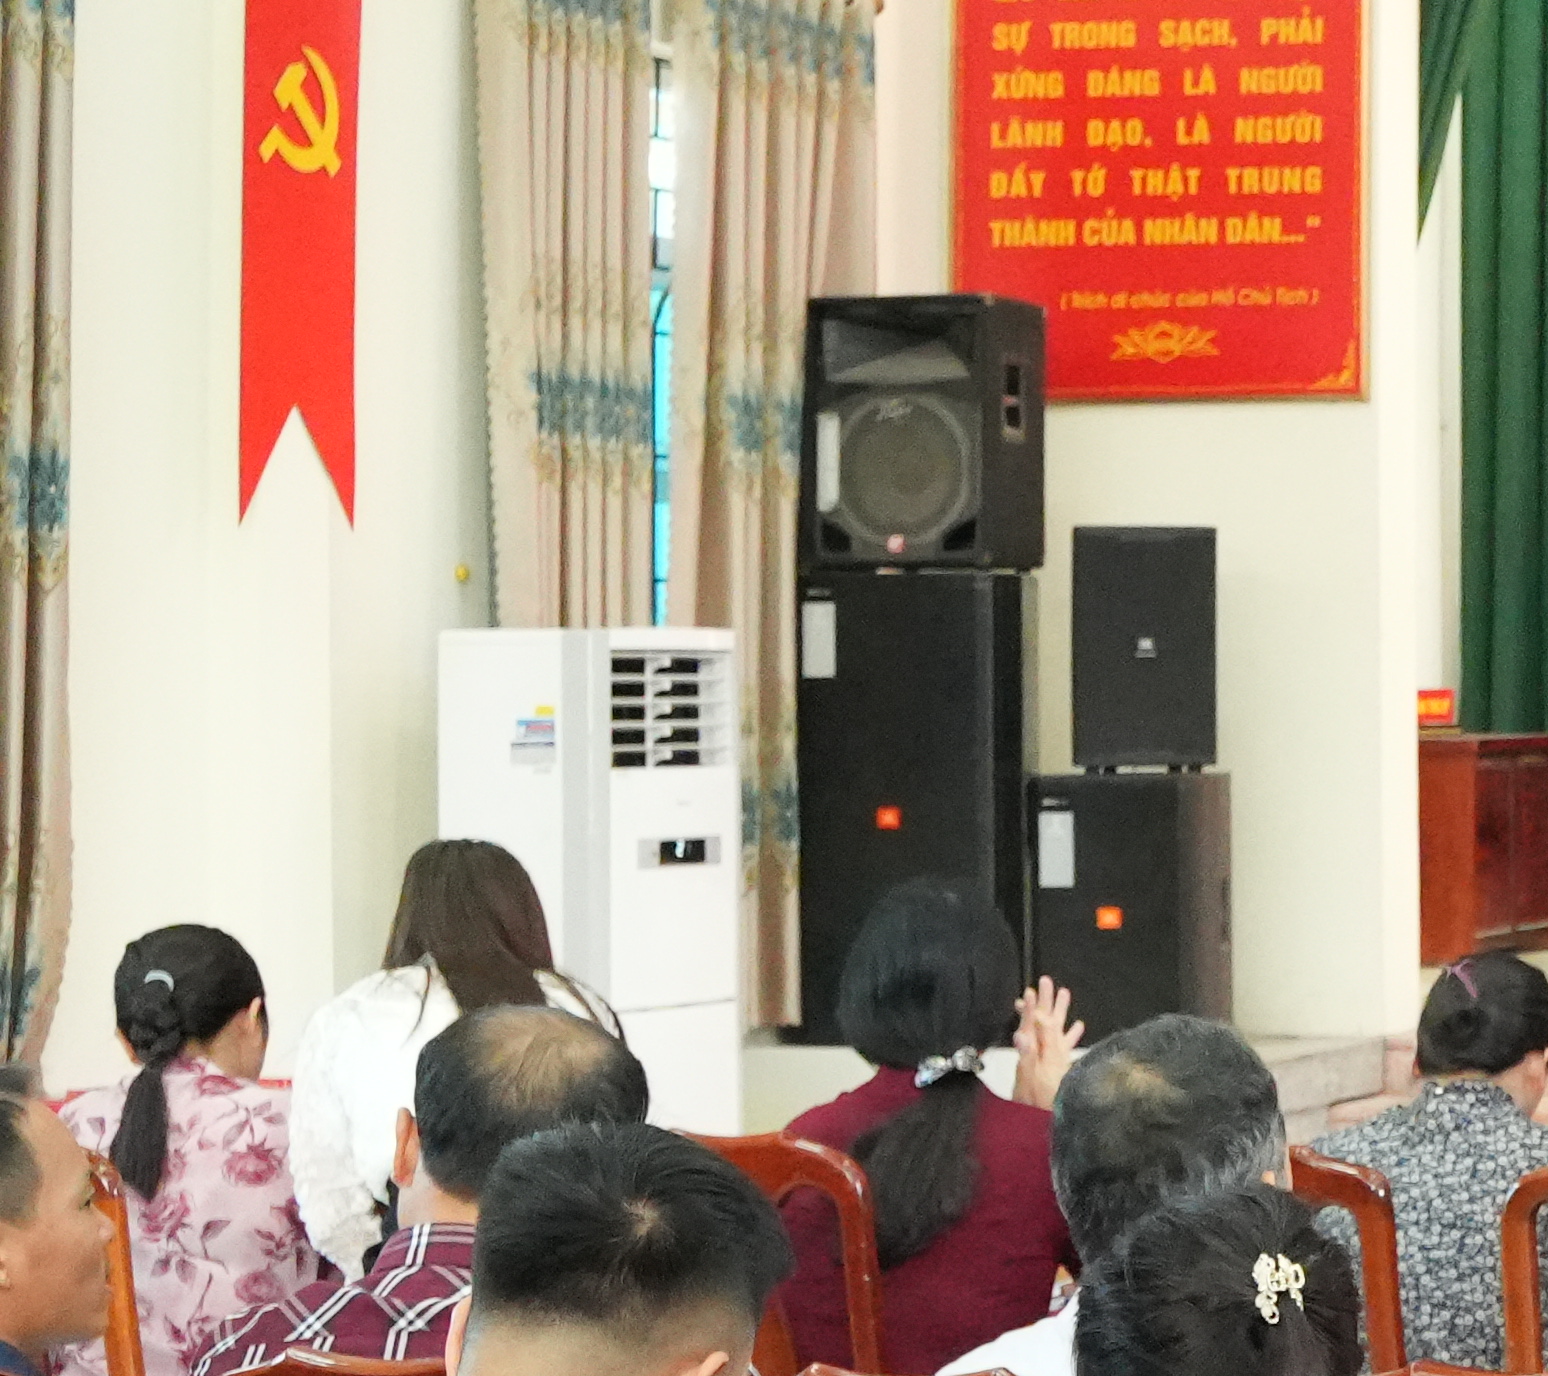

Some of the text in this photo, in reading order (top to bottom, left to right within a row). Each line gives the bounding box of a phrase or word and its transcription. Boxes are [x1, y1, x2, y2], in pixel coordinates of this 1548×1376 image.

[992, 7, 1323, 54] SỰ TRONG PHẢI
[1088, 66, 1160, 96] ĐÁNG
[1184, 64, 1215, 94] LÀ
[1177, 113, 1210, 144] LÀ
[1131, 163, 1200, 200] THẬT
[1226, 167, 1322, 193] TRUNG
[989, 209, 1218, 247] THÀNH CỦA NHÂN
